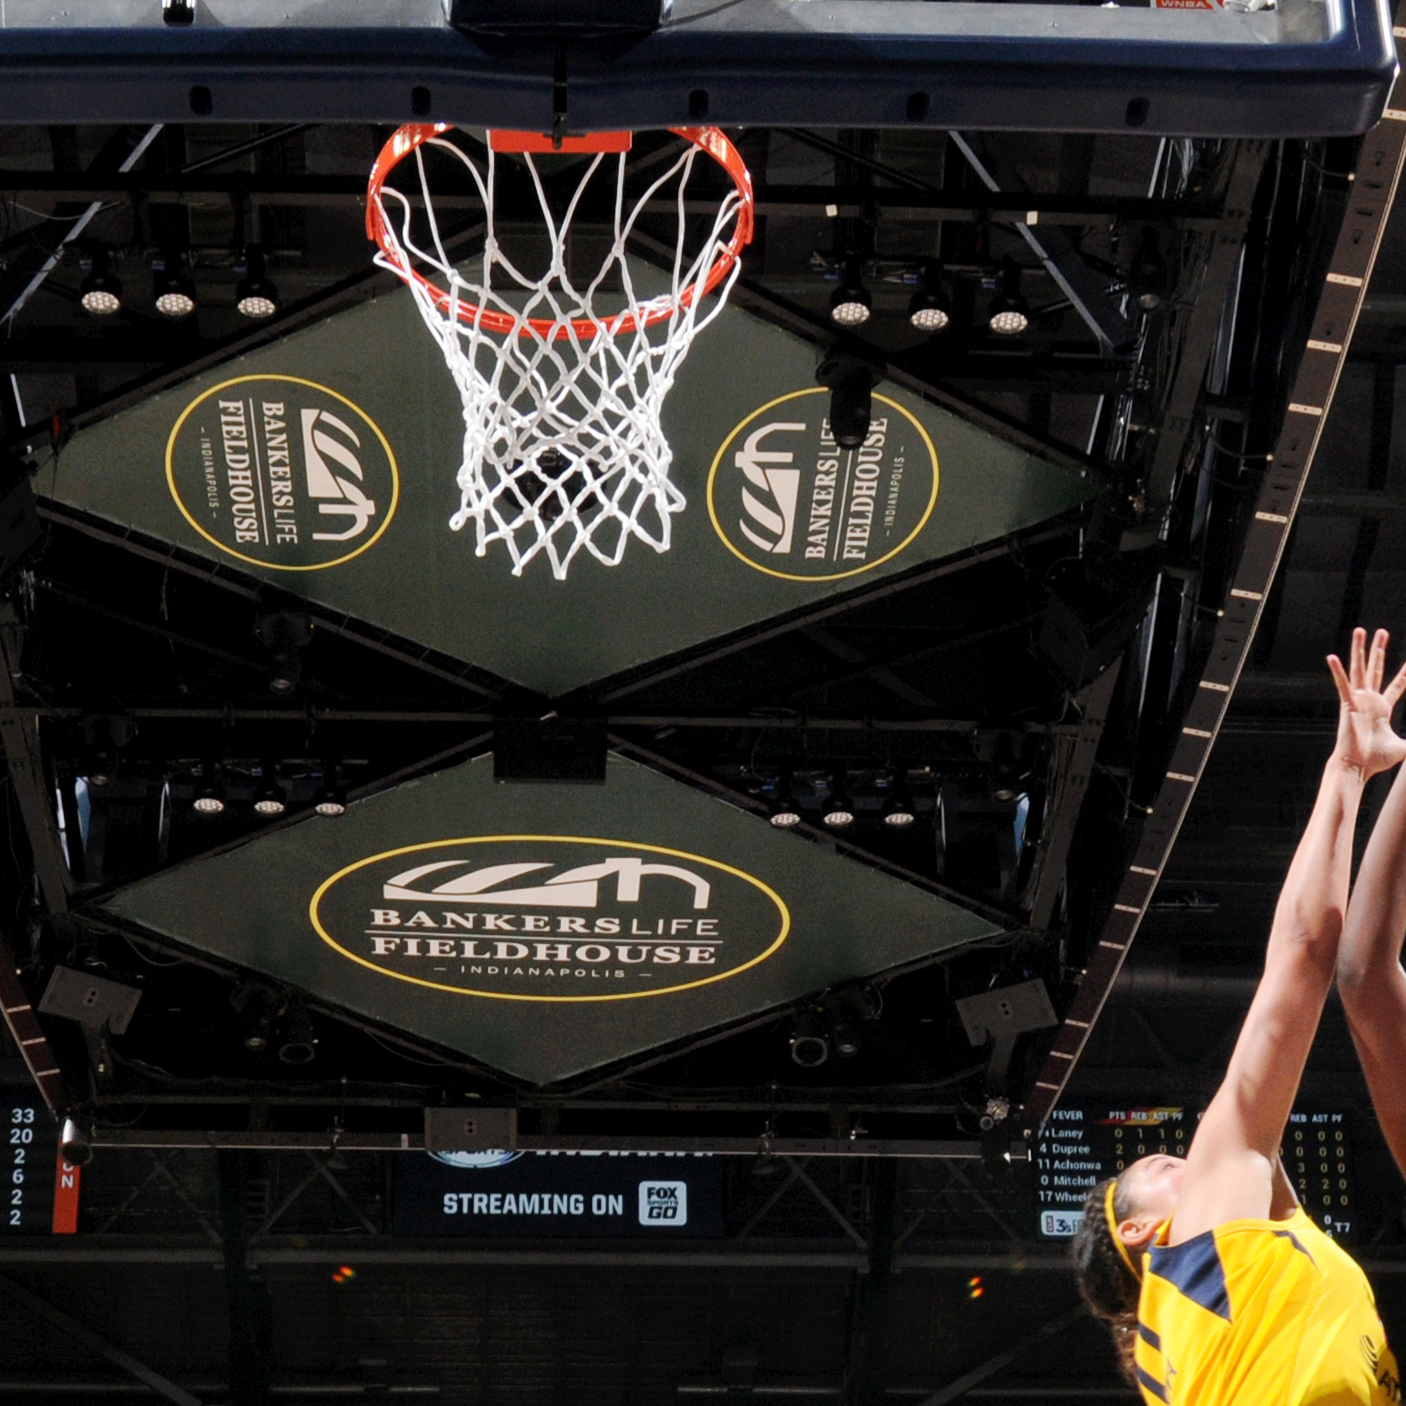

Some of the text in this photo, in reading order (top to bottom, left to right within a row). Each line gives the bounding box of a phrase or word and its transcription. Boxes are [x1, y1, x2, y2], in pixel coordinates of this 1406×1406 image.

[201, 438, 219, 508] INDIANAPOLIS
[219, 399, 259, 543] FIELDHOUSE
[262, 401, 298, 544] BANKERS LIFE
[843, 418, 888, 560] FIELDHOUSE
[884, 457, 905, 526] INDIANAPOLIS
[805, 459, 839, 559] BANKERS
[370, 909, 719, 936] BANKERS LIFE
[370, 937, 716, 965] FIELDHOUSE
[460, 965, 626, 979] INDIANAPOLIS
[11, 1108, 34, 1123] 33
[1053, 1110, 1083, 1120] FEVER
[1109, 1111, 1125, 1120] PTS
[1153, 1112, 1168, 1120] AST
[1172, 1112, 1183, 1121] PF
[1312, 1114, 1328, 1123] AST
[10, 1128, 33, 1144] 20
[1051, 1128, 1083, 1140] Laney
[1115, 1128, 1122, 1138] 0
[14, 1149, 25, 1164] 2
[1039, 1143, 1090, 1156] 4 Dupree
[1038, 1159, 1101, 1170] 11 Achonwa
[12, 1169, 24, 1184] 6
[1041, 1176, 1096, 1186] 0 Mitchell
[11, 1189, 22, 1204] 2
[647, 1187, 678, 1199] FOX
[1039, 1191, 1052, 1201] 17
[443, 1193, 623, 1215] STREAMING ON
[10, 1210, 21, 1225] 2
[647, 1206, 678, 1219] GO
[1324, 1215, 1332, 1225] 0
